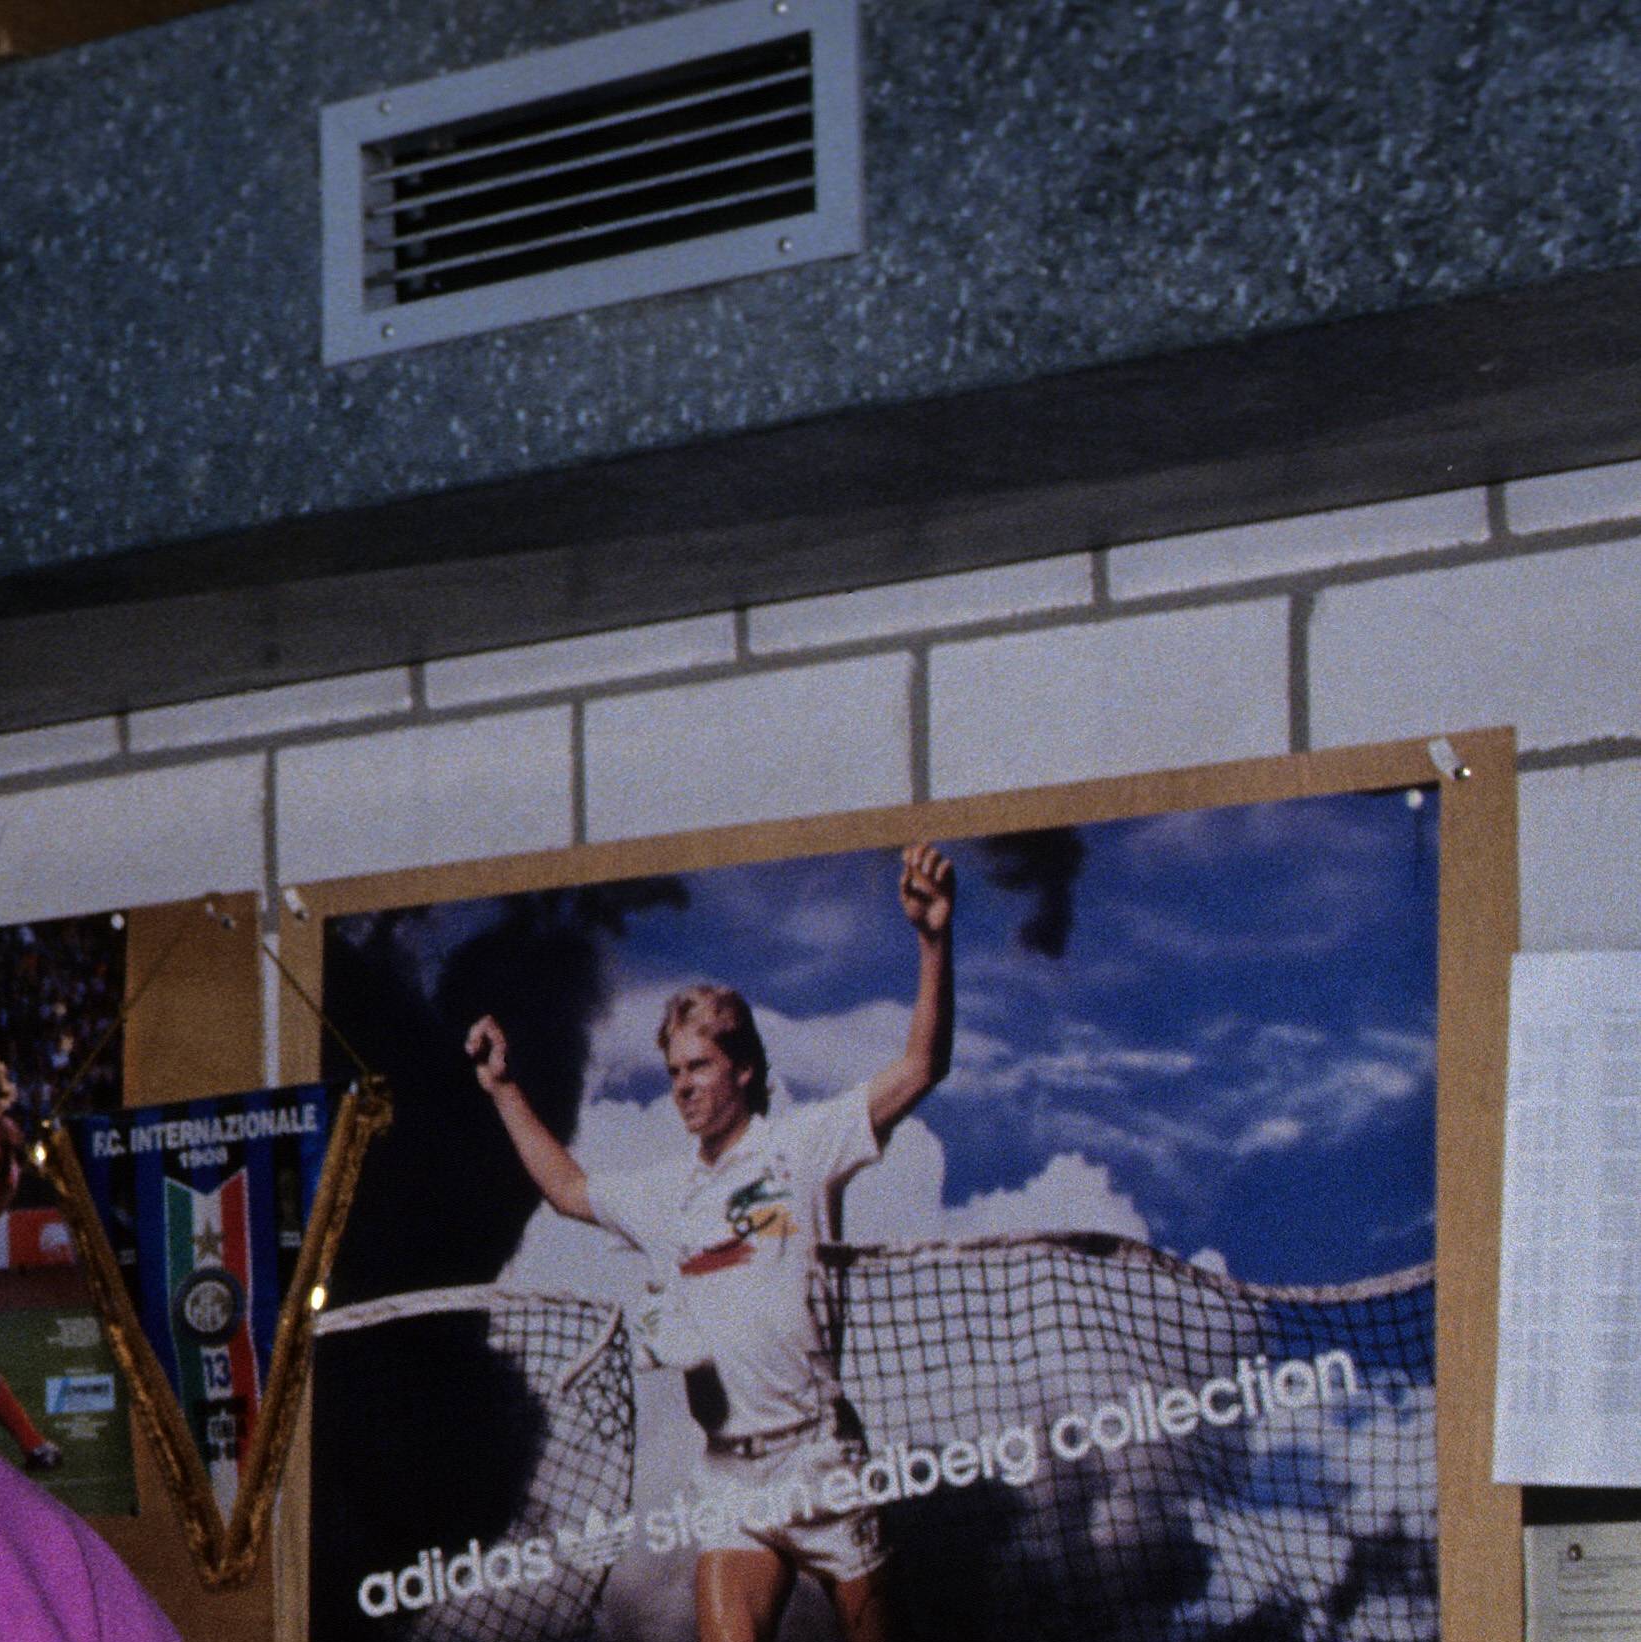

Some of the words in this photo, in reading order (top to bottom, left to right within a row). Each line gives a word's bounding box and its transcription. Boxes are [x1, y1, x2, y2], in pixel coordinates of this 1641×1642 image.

[128, 1102, 319, 1154] INTERNAZIONALE
[357, 1535, 555, 1618] adidas
[821, 1424, 1039, 1512] edberg
[1051, 1348, 1358, 1461] collection
